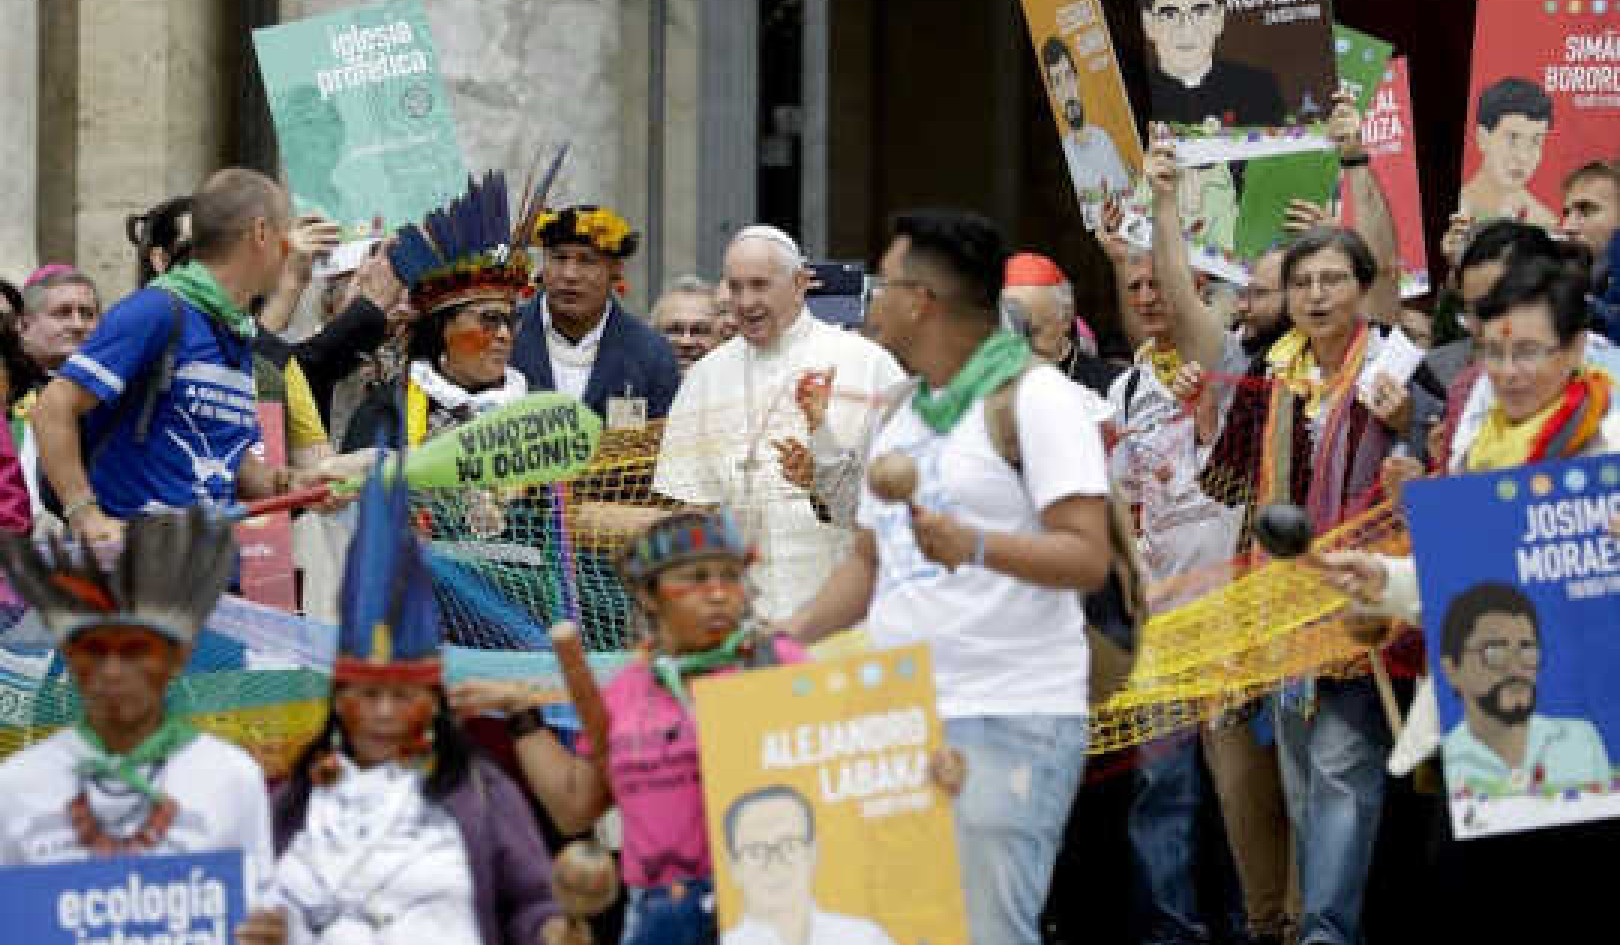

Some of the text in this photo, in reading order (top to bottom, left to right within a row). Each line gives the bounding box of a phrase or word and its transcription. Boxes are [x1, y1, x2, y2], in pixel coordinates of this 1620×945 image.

[330, 20, 412, 63] iglesia
[317, 49, 427, 101] profética
[762, 706, 926, 769] ALEJANDRO
[820, 748, 927, 801] LABAKA
[57, 866, 226, 931] ecología
